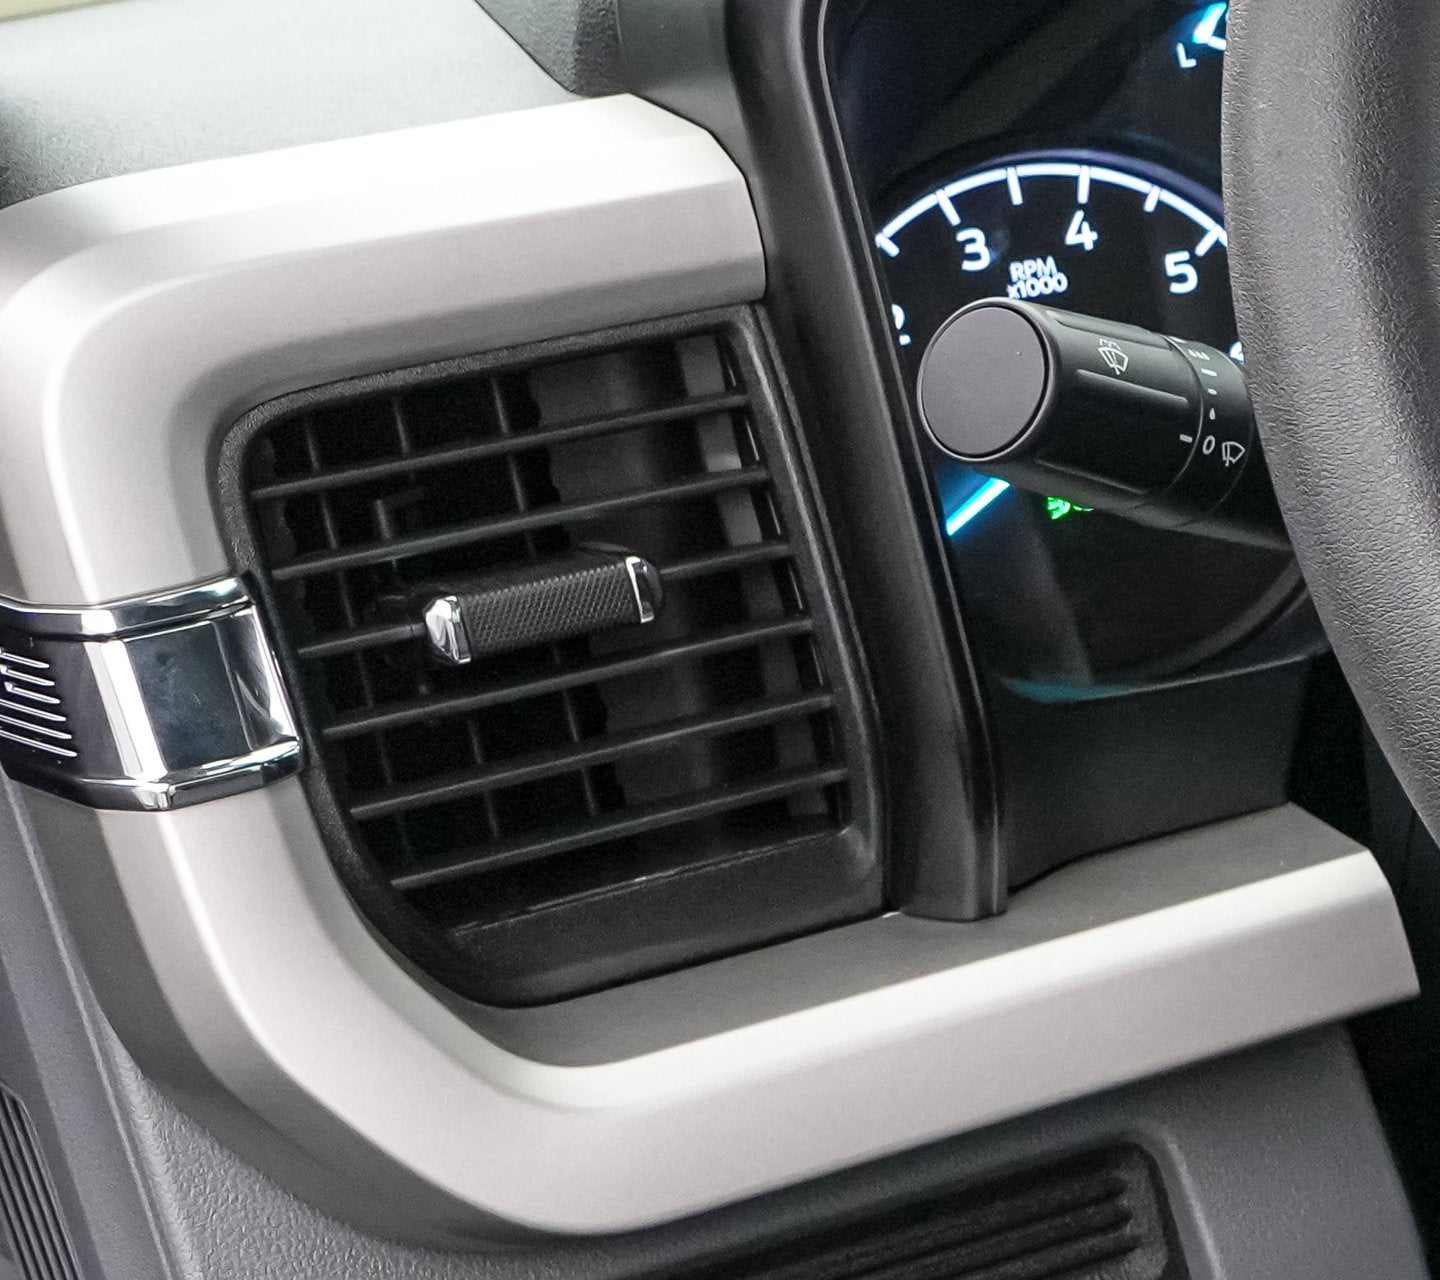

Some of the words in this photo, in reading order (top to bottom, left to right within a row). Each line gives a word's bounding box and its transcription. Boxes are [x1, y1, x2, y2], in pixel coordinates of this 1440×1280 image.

[1176, 42, 1197, 68] L
[954, 227, 992, 271] 3
[1064, 210, 1099, 251] 4
[1008, 255, 1059, 283] RPM
[1164, 251, 1199, 294] 5
